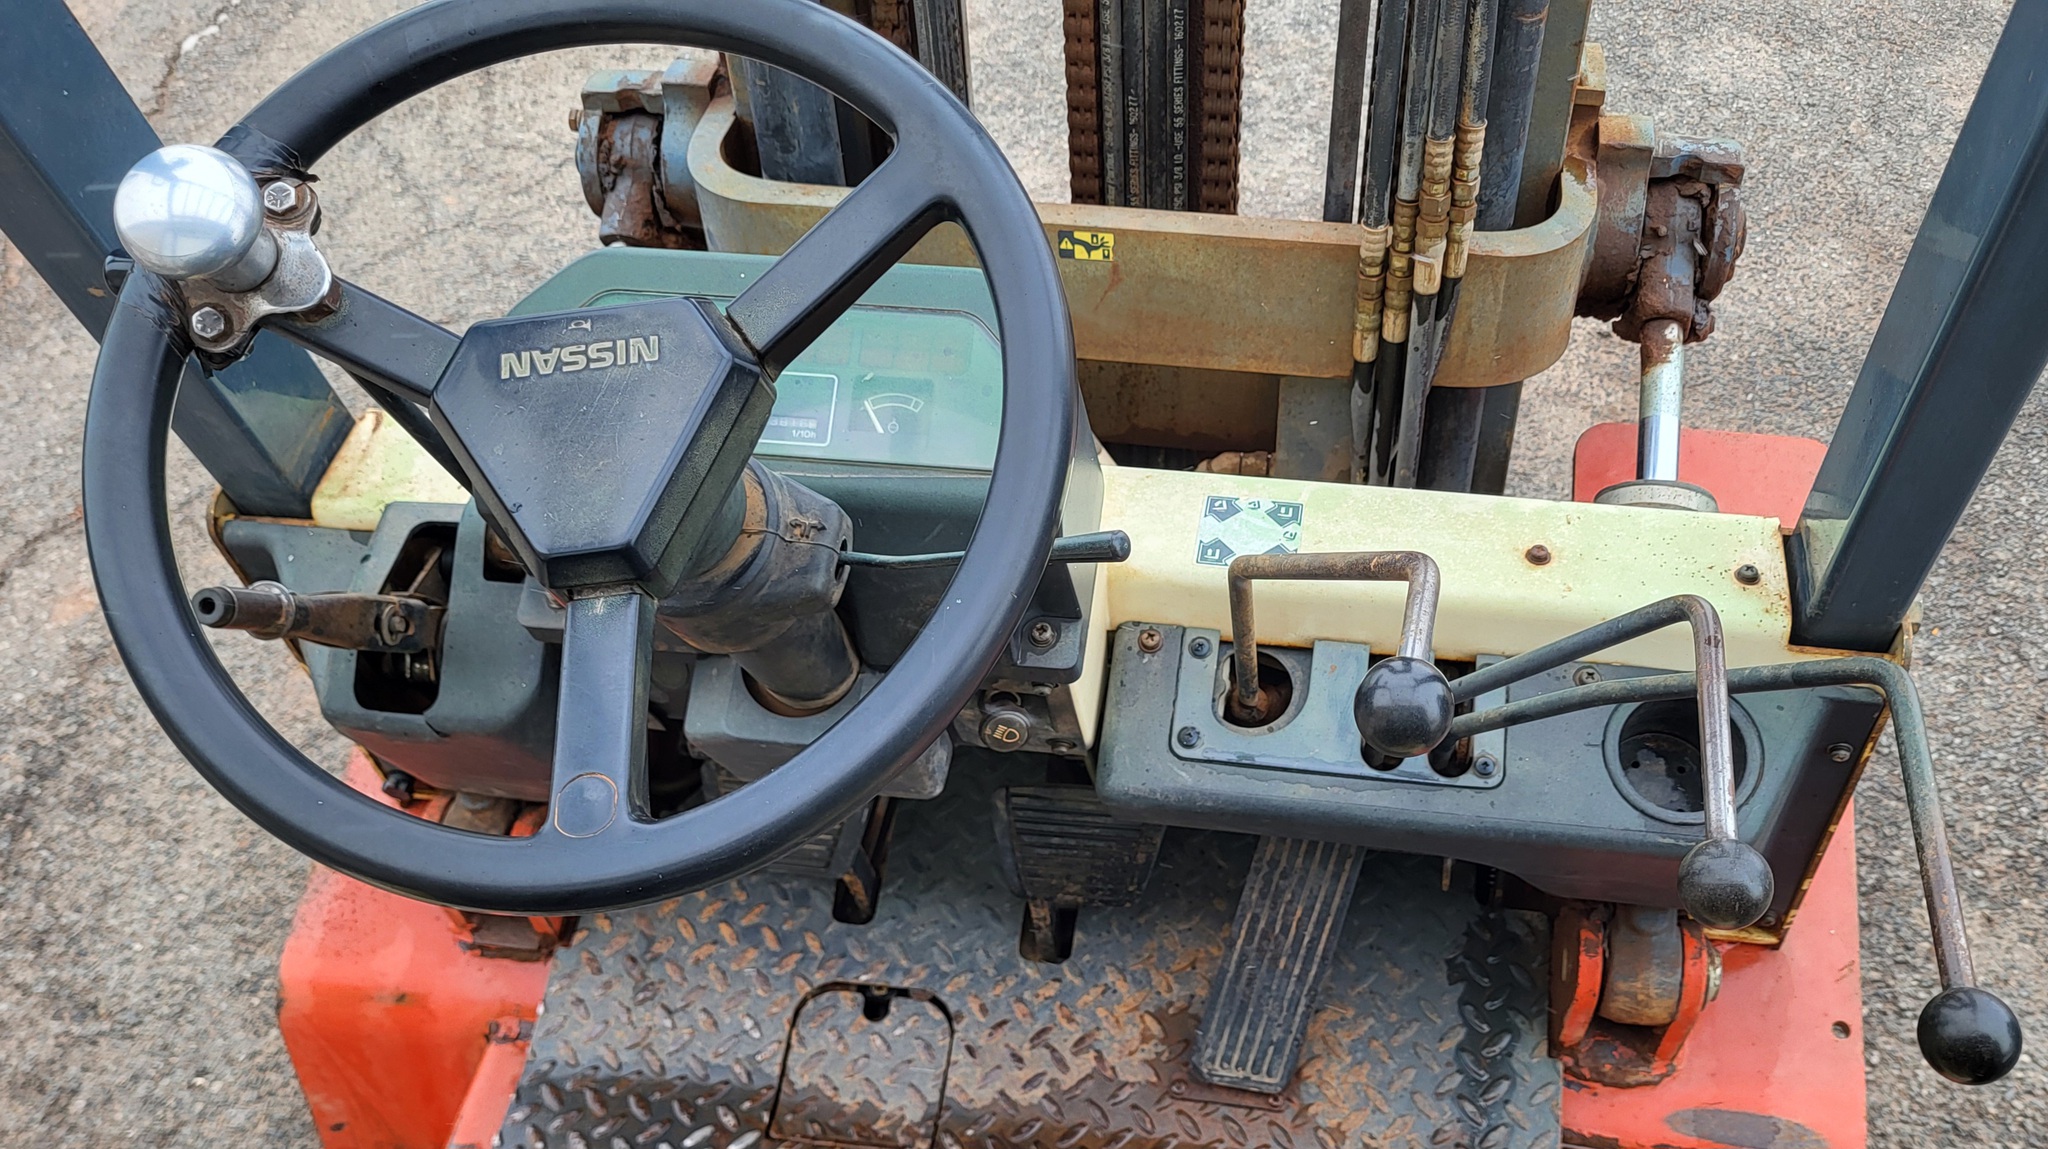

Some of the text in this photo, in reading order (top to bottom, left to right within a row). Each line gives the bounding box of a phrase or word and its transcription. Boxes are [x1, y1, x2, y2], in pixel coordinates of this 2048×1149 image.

[1173, 9, 1184, 40] 160277
[1173, 86, 1184, 114] SERIES
[1173, 117, 1184, 128] 55
[1129, 167, 1139, 194] SERIES
[1173, 166, 1183, 180] 3/8
[1107, 184, 1116, 206] rker
[1173, 183, 1183, 195] PSI
[500, 335, 659, 379] NISSAN
[792, 429, 817, 439] 1/10h
